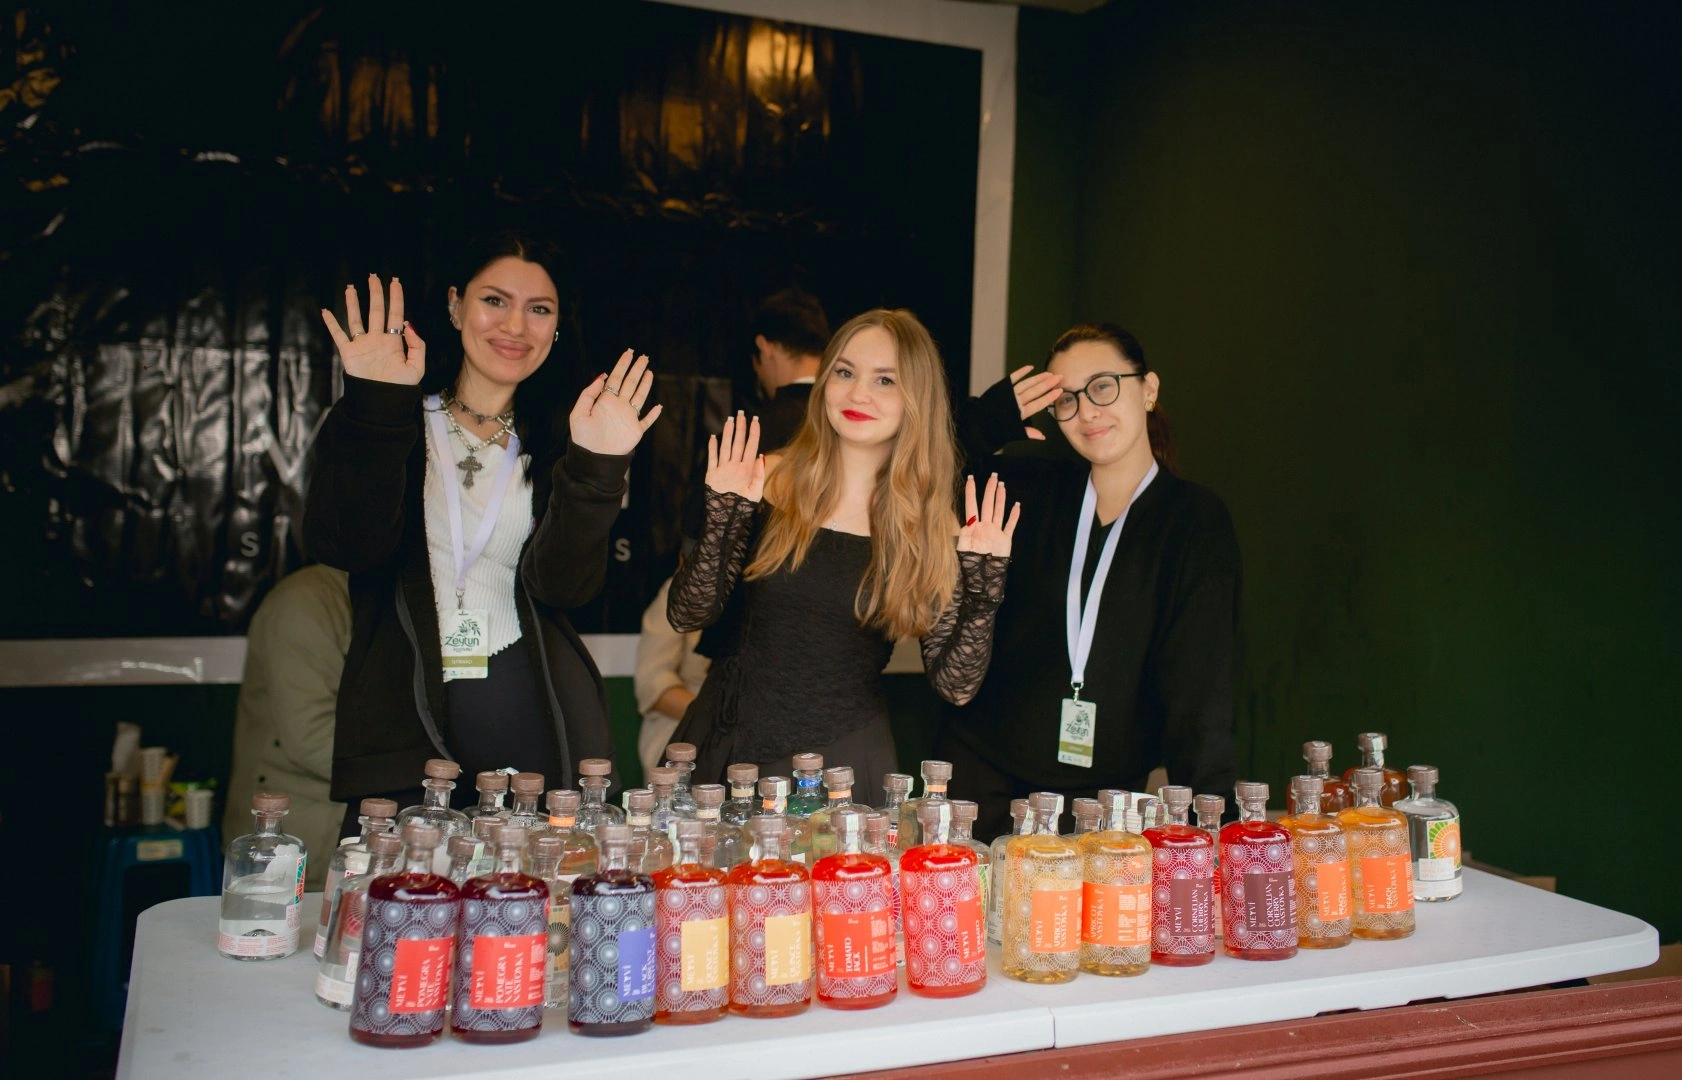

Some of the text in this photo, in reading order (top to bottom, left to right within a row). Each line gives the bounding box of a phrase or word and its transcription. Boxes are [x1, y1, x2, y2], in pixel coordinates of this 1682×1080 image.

[1265, 884, 1274, 927] CORNELIAN
[1278, 885, 1286, 926] NASTOYKA
[1390, 869, 1399, 908] NASTOYKA
[1096, 899, 1104, 939] NASTOYKA
[845, 937, 853, 972] TOMATO
[417, 959, 430, 1007] POMEGRA
[426, 983, 435, 1007] NATE
[432, 954, 445, 1005] NASTOYKA
[496, 956, 507, 1003] POMEGRA
[505, 979, 514, 1003] NATE
[512, 952, 524, 1002] NASTOYKA
